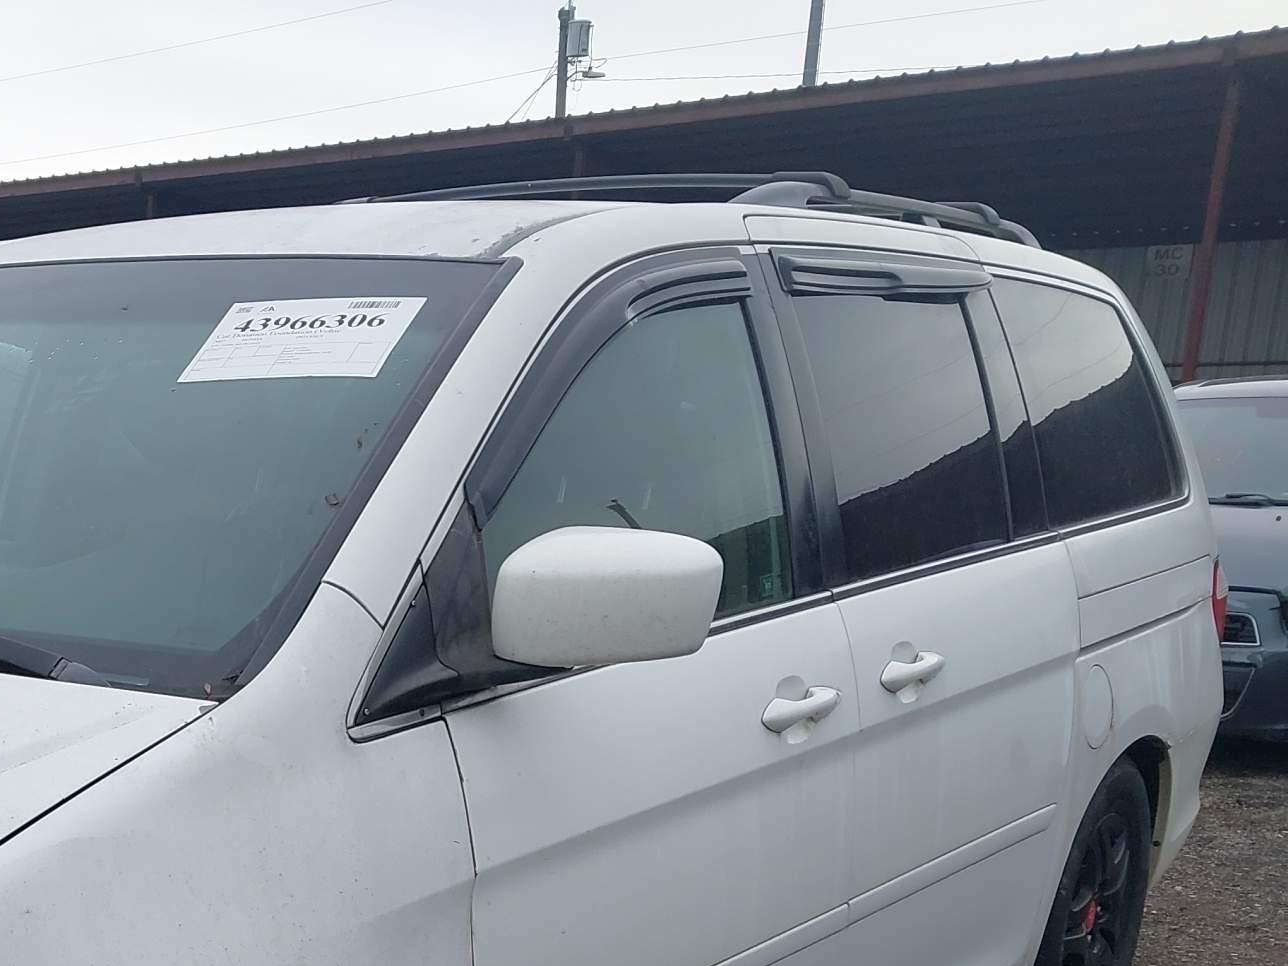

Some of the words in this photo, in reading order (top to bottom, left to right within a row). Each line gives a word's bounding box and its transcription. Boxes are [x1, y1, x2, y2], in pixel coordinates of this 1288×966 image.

[1154, 247, 1183, 261] MC
[1154, 264, 1179, 277] 30
[234, 313, 389, 333] 43966306
